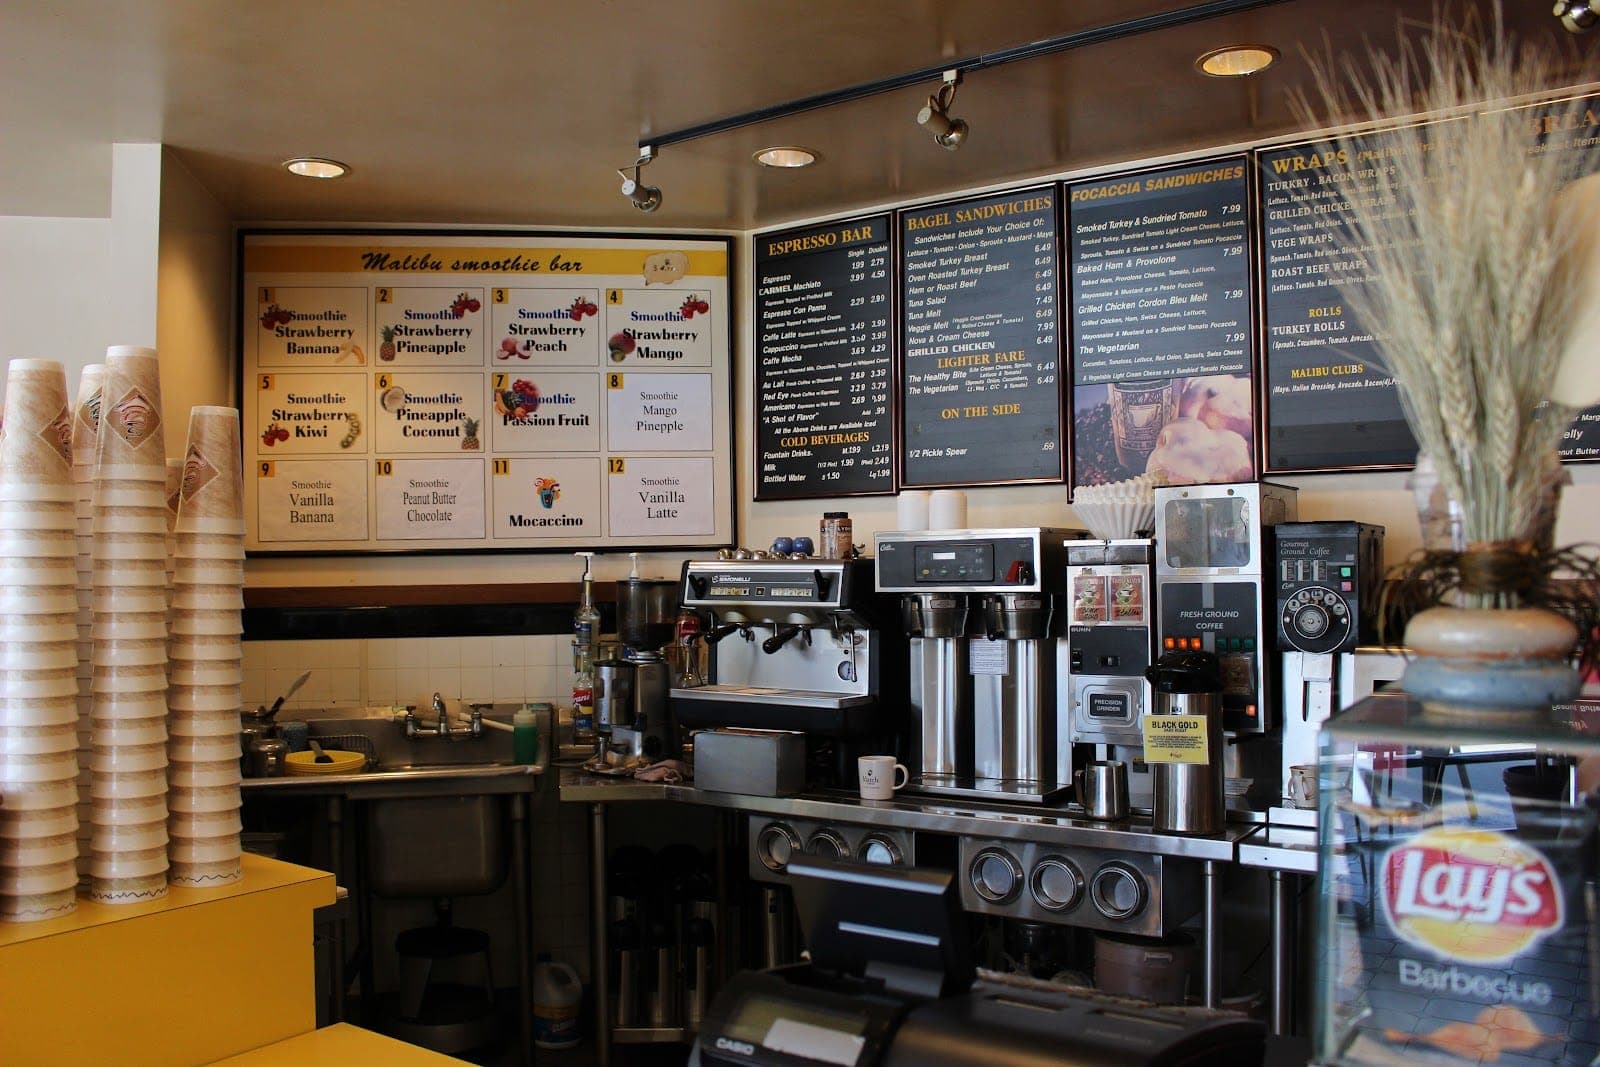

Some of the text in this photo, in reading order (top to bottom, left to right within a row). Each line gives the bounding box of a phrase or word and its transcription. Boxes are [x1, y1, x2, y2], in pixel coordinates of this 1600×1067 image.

[1272, 151, 1349, 174] WRAPS
[1072, 166, 1243, 202] FOCACCIA SANDWICHES
[908, 196, 1052, 230] BAGEL SANDWICHES
[1077, 205, 1240, 234] Smoked Turkey & Sundried Tomato 7.99
[1270, 206, 1311, 220] GRILLED
[915, 233, 956, 245] Sandwiches
[958, 228, 983, 238] Include
[987, 225, 1002, 233] Your
[1005, 221, 1030, 231] Choice
[1081, 238, 1101, 246] Smoked
[1122, 232, 1144, 241] Sundried
[1146, 229, 1164, 237] Tomato
[1166, 227, 1179, 235] Light
[1181, 225, 1198, 233] Cream
[769, 226, 872, 256] ESPRESSO BAR
[1271, 233, 1333, 248] VEGE WRAPS
[869, 246, 887, 254] Double
[908, 243, 1051, 270] Smoked Turkey Breast 6.49
[361, 252, 583, 271] Malibu smoothie bar
[1077, 246, 1242, 273] Baked Ham & Provolone 7.99
[908, 257, 1051, 283] Oven Roasted Turkey Breast 6.49
[1272, 260, 1368, 278] ROAST BEEF WRAPS
[763, 270, 885, 284] Espresso 3.99 4.50
[909, 286, 924, 294] Ham
[937, 282, 957, 291] Roast
[960, 279, 977, 288] Beef
[1035, 270, 1052, 279] 6.49
[759, 285, 792, 296] CARMEL
[1078, 290, 1242, 314] Grilled Chicken Cordon Bleu Melt 7.99
[289, 311, 346, 321] Smoothie
[764, 309, 791, 319] Espresso
[808, 304, 826, 312] Panna
[1308, 306, 1342, 318] ROLLS
[908, 323, 931, 333] Veggie
[934, 321, 948, 330] Melt
[1036, 309, 1053, 318] 6.49
[275, 326, 354, 338] Strawberry
[395, 325, 472, 338] Strawberry
[508, 324, 586, 336] Strawberry
[623, 328, 698, 341] Strawberry
[909, 336, 926, 344] Nova
[937, 333, 960, 342] Cream
[963, 330, 989, 339] Cheese
[1037, 322, 1054, 331] 7.99
[1272, 321, 1345, 335] TURKEY ROLLS
[287, 343, 340, 354] Banana
[397, 341, 466, 355] Pineapple
[526, 340, 567, 351] Peach
[908, 335, 1053, 357] GRILLED CHICKEN 6.49
[1080, 333, 1245, 354] The Vegetarian 7.99
[637, 347, 683, 360] Mango
[937, 354, 989, 369] LIGHTER
[995, 350, 1025, 362] FARE
[924, 373, 950, 382] Healthy
[953, 371, 967, 379] Bite
[1037, 362, 1054, 371] 6.49
[1291, 364, 1364, 378] MALIBU CLUBS
[287, 394, 346, 404] Smoothie
[404, 394, 463, 403] Smoothie
[272, 409, 351, 422] Strawberry
[397, 409, 466, 422] Pineapple
[643, 406, 677, 417] Mango
[941, 403, 1021, 419] ON THE SIDE
[503, 415, 589, 426] Passion Fruit
[637, 421, 683, 432] Pinepple
[296, 426, 327, 437] Kiwi
[403, 425, 460, 437] Coconut
[1563, 429, 1582, 440] elly
[781, 432, 869, 447] COLD BEVERAGES
[495, 461, 507, 472] 11
[610, 460, 623, 472] 12
[875, 457, 889, 465] 2.49
[377, 462, 391, 474] 10
[289, 494, 334, 506] Vanilla
[403, 492, 456, 504] Peanut Butter
[639, 492, 684, 503] Vanilla
[290, 511, 334, 523] Banana
[408, 510, 452, 521] Chocolate
[647, 508, 677, 518] Latte
[509, 515, 583, 527] Mocaccino
[1310, 547, 1330, 557] Coffee
[1152, 721, 1198, 729] BLACK GOLD
[1395, 850, 1547, 923] Lay's
[1399, 959, 1552, 1003] Barbecue
[716, 1038, 754, 1055] CASIO
